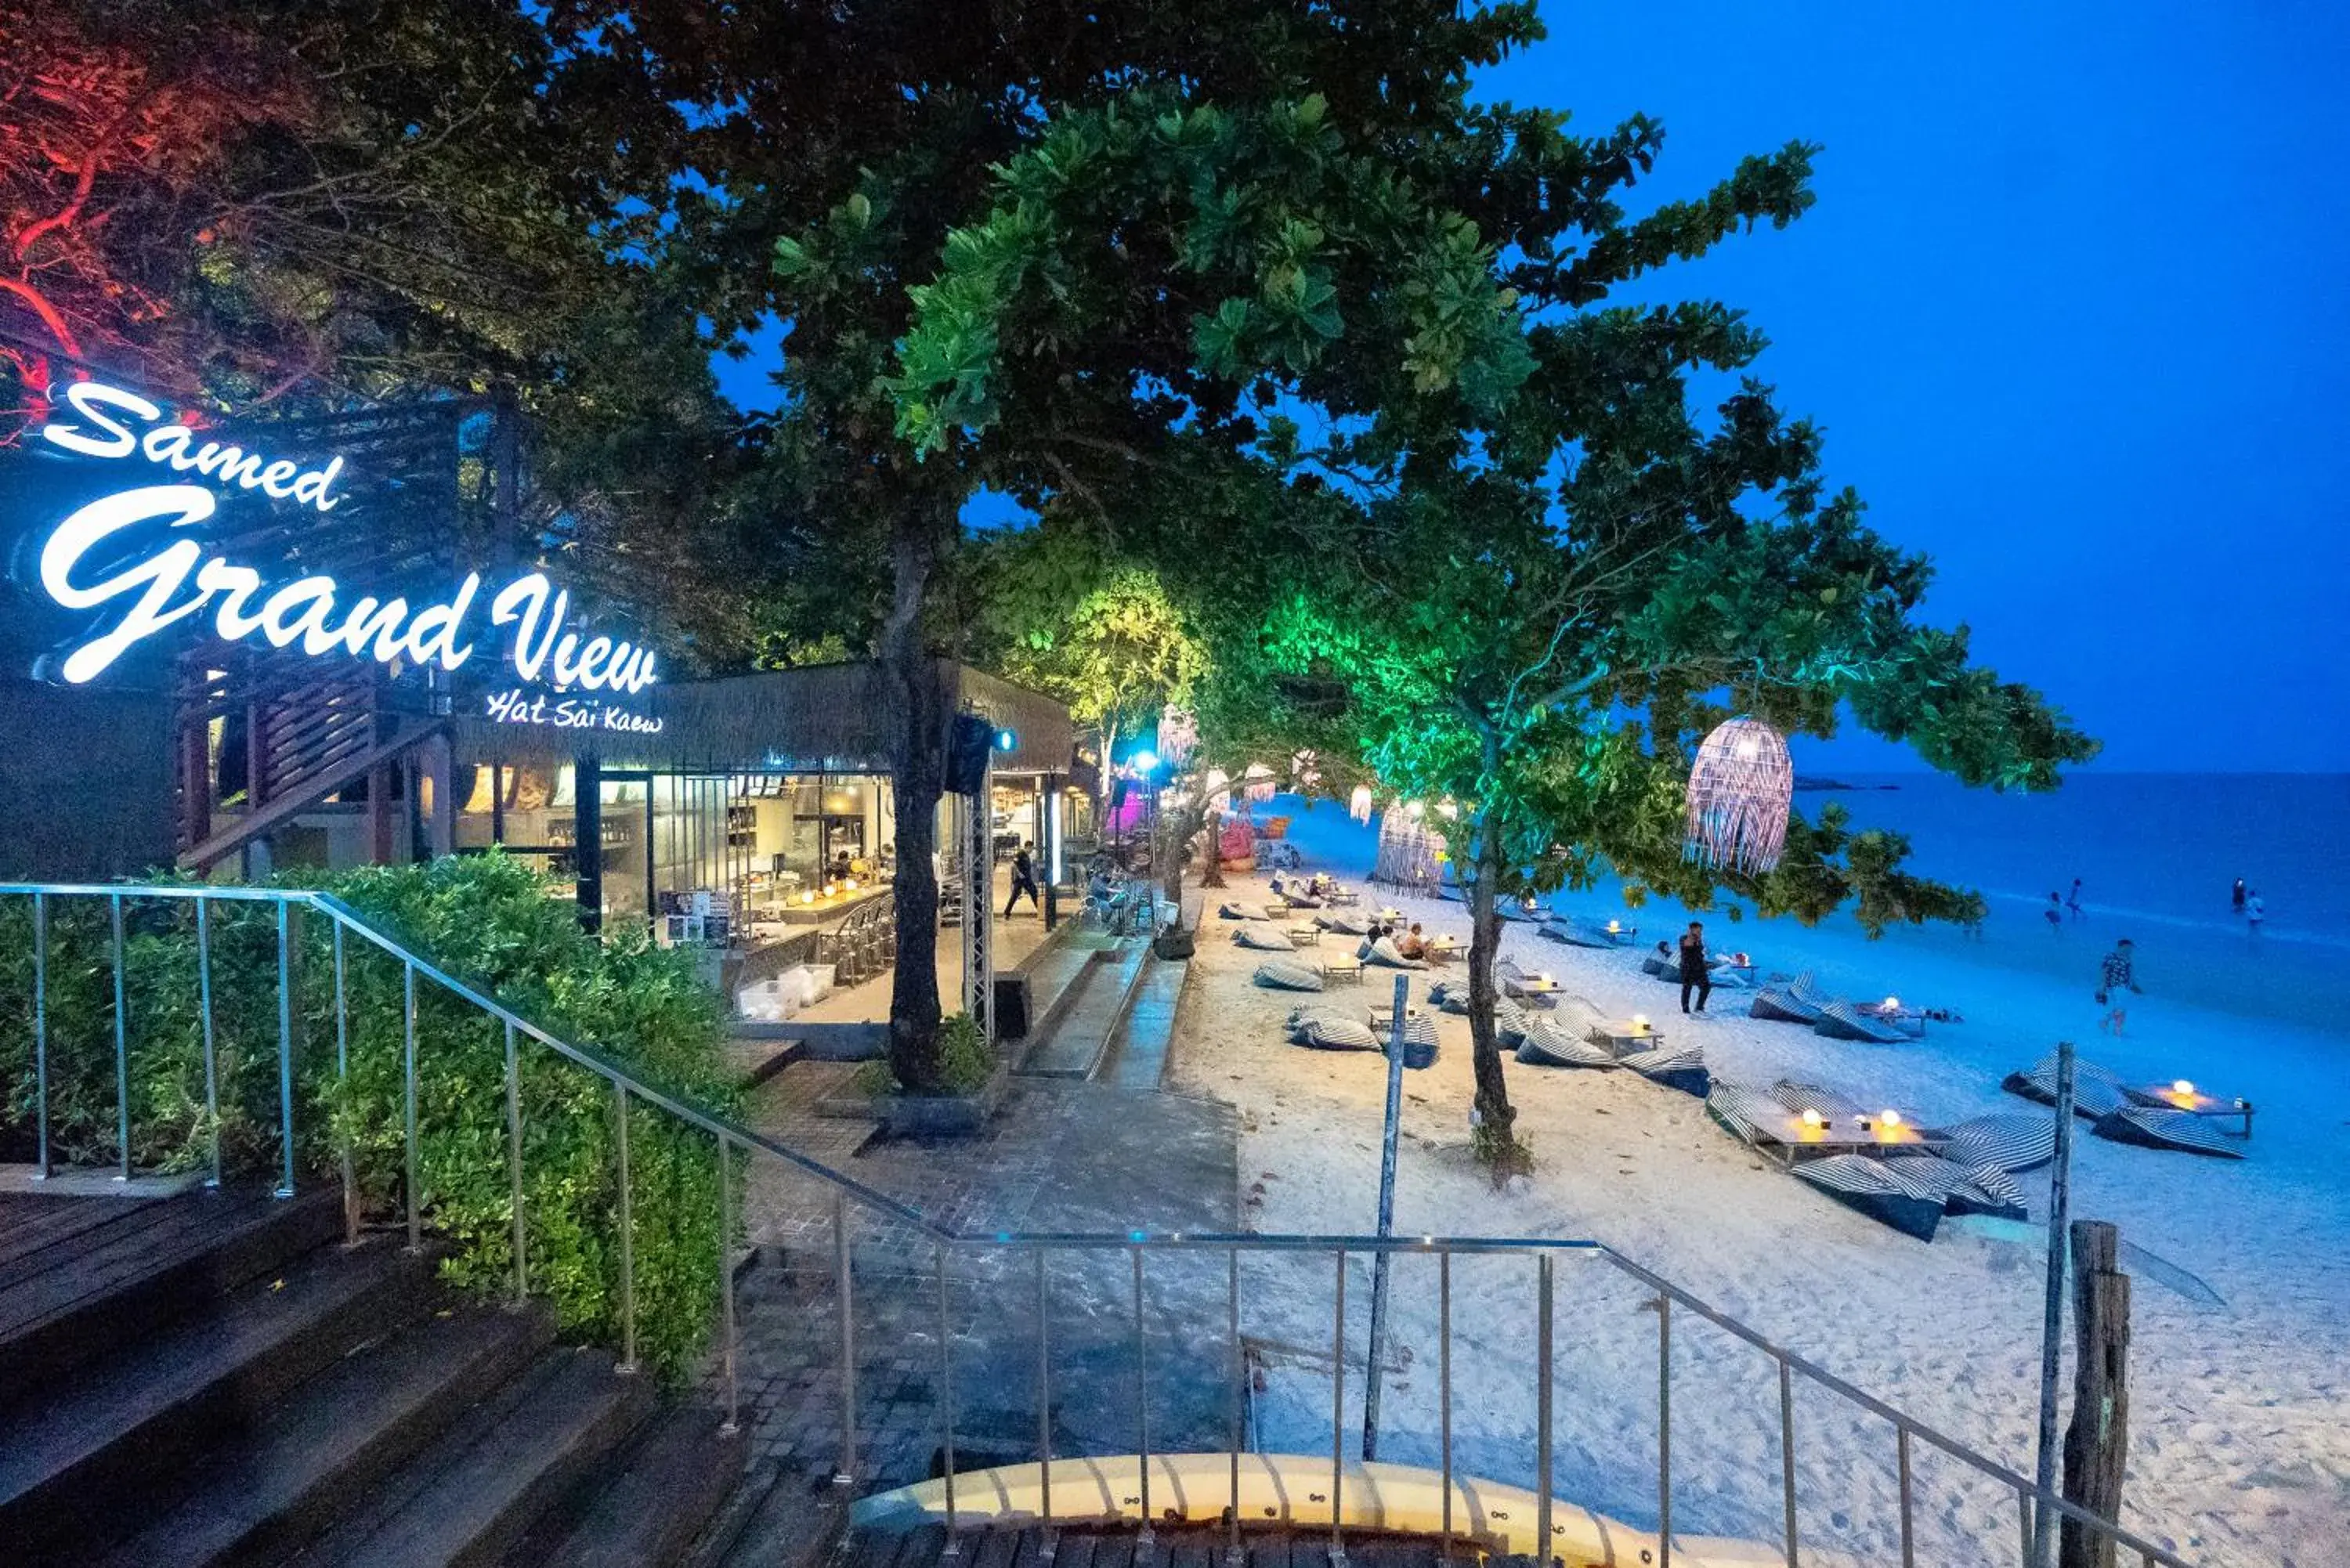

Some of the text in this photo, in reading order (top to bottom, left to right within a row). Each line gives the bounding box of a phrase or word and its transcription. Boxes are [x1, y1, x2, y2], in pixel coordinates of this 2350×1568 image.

[43, 381, 343, 511] Samed
[41, 485, 656, 694] Grand View
[487, 688, 663, 733] Hat Sai Kaew
